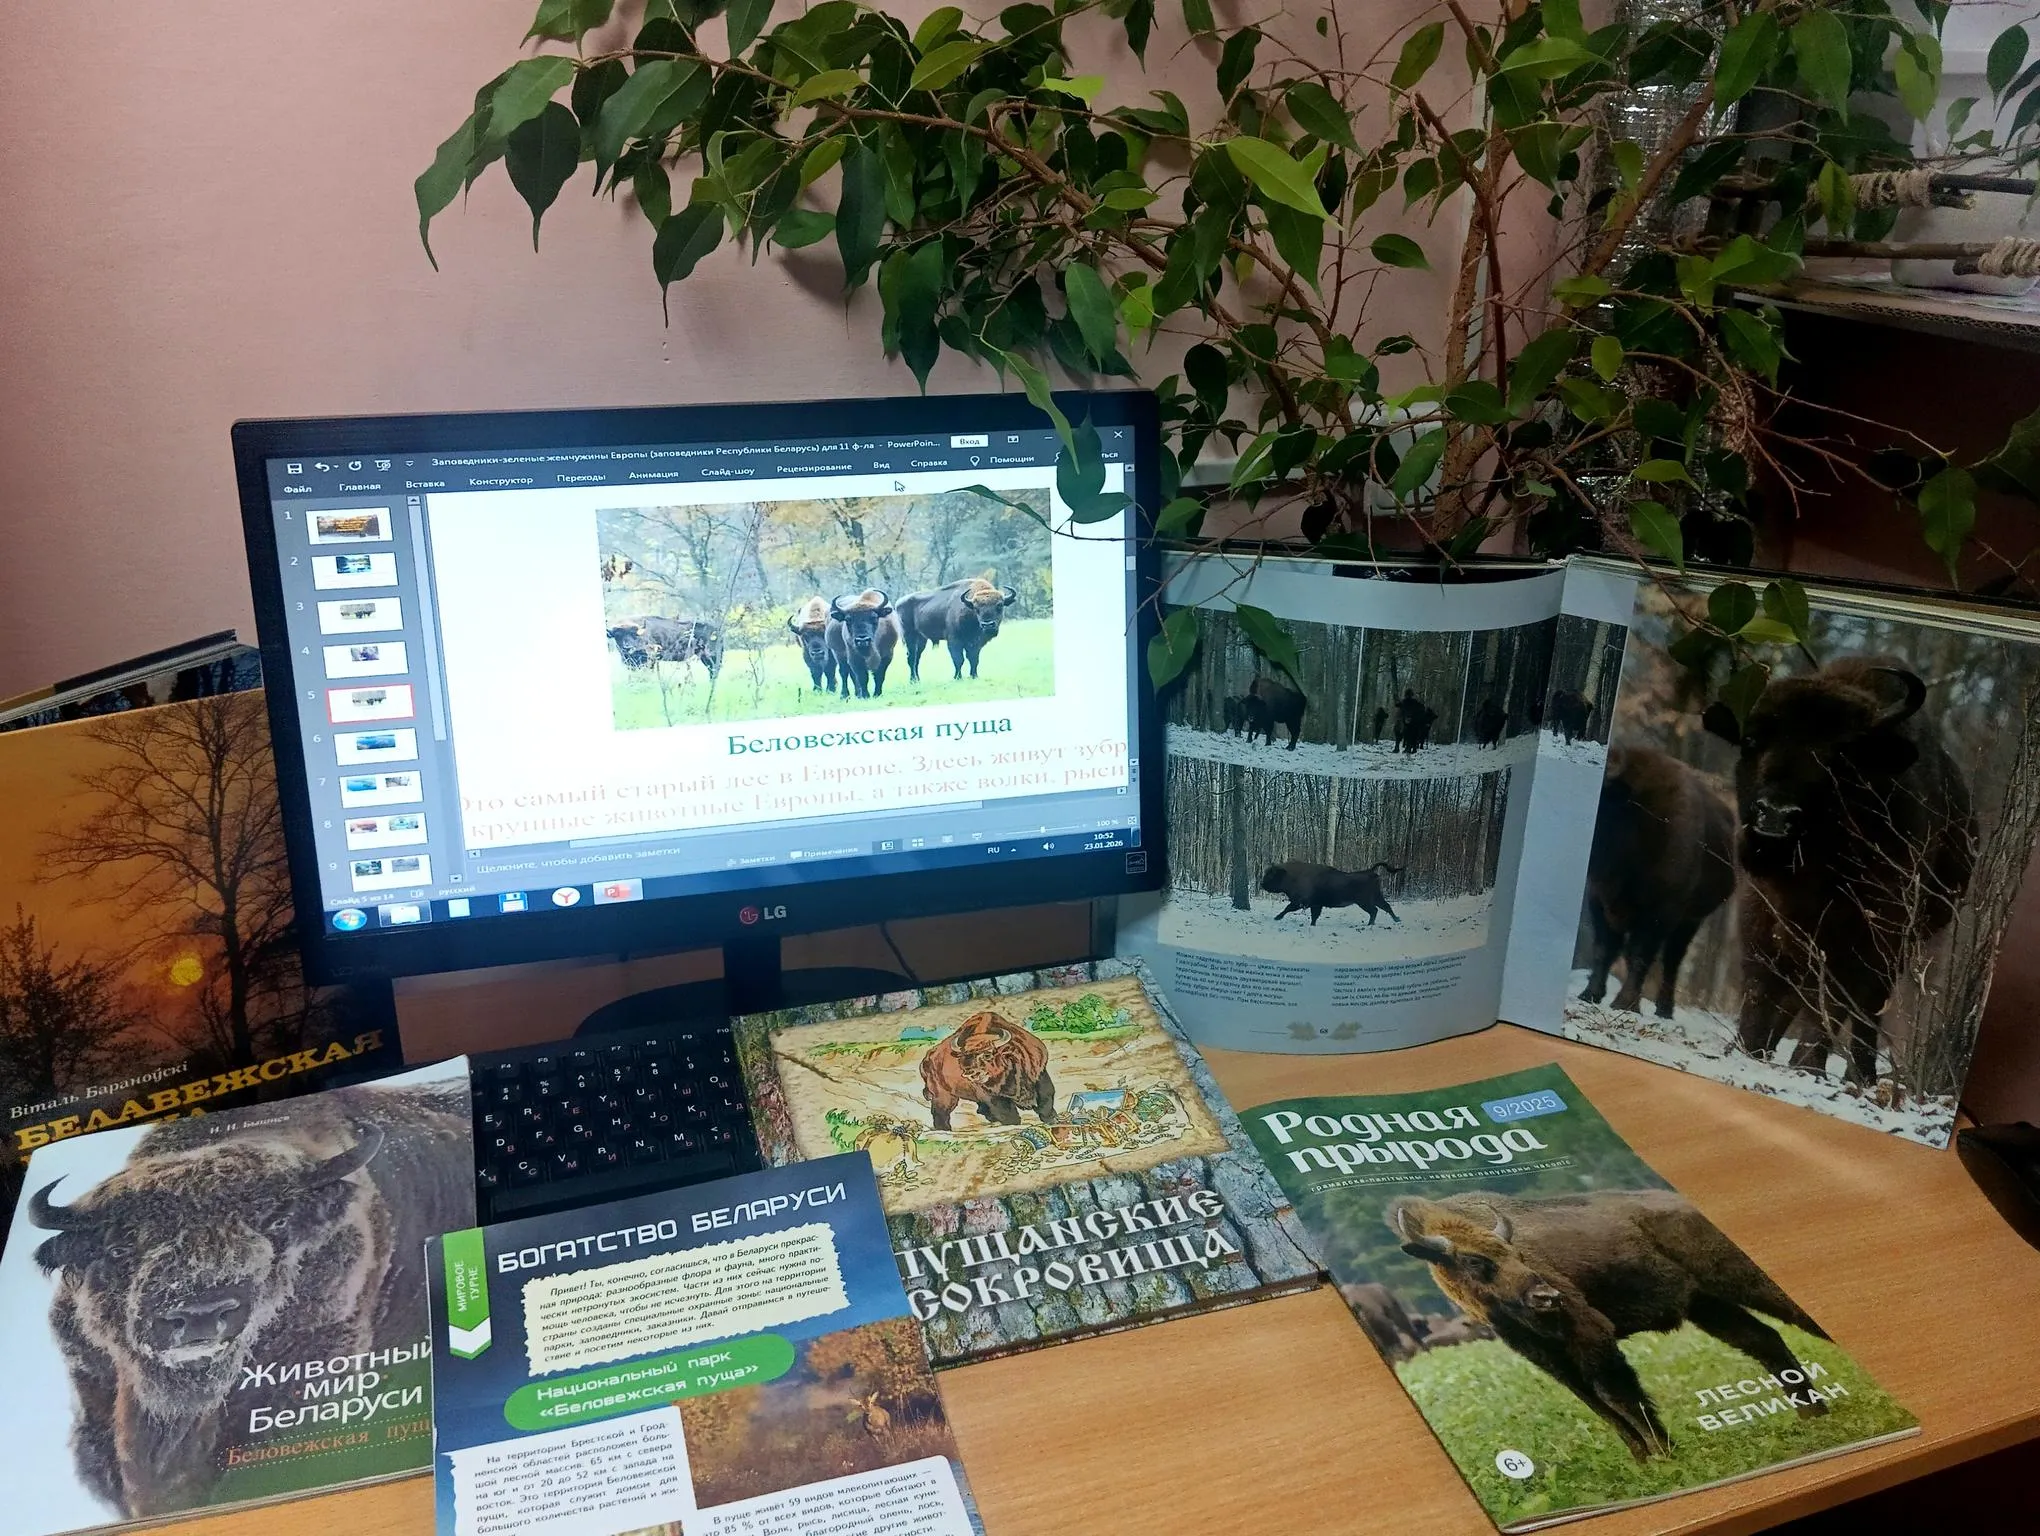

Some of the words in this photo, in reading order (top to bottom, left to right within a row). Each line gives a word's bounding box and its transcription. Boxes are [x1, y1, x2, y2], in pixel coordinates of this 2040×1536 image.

[431, 453, 545, 466] Заповедники-зеленые
[546, 452, 608, 463] жемчужины
[611, 451, 648, 460] Европы
[650, 447, 714, 459] (заповедники
[716, 446, 772, 456] Республики
[774, 443, 820, 455] Беларусь)
[822, 444, 838, 452] для
[852, 442, 874, 452] ф-ла
[960, 437, 980, 446] Вход
[284, 485, 312, 494] Файл
[339, 483, 381, 492] Главная
[405, 480, 446, 489] Вставка
[469, 476, 534, 487] Конструктор
[557, 474, 606, 484] Переходы
[629, 471, 679, 480] Анимация
[701, 466, 756, 478] Слайд-шоу
[777, 463, 852, 474] Рецензирование
[873, 461, 890, 470] Вид
[911, 458, 948, 468] Справка
[990, 454, 1034, 464] Помощни
[728, 724, 924, 756] Беловежская
[935, 716, 1012, 742] пуща
[513, 783, 606, 808] самый
[616, 774, 716, 800] старый
[726, 771, 769, 789] лес
[911, 755, 983, 774] Здесь
[991, 746, 1068, 769] живут
[470, 813, 597, 842] крупные
[605, 799, 745, 827] животные
[896, 777, 969, 797] также
[987, 846, 1000, 855] RU
[1084, 840, 1124, 850] 23.01.2026
[1094, 831, 1114, 840] 10:52
[764, 904, 787, 920] LG
[10, 1093, 80, 1120] Віталь
[84, 1060, 190, 1100] Бараноўскі
[13, 1027, 385, 1152] БЕЛАВЕЖСКАЯ
[688, 1104, 696, 1113] K
[1492, 1096, 1557, 1118] 9/2025
[1259, 1105, 1481, 1144] Родная
[1285, 1127, 1549, 1175] прырода
[498, 1219, 678, 1274] БОГАТСТВО
[692, 1182, 847, 1233] БЕЛАРУСИ
[470, 1266, 480, 1301] ТУРНЕ
[540, 1302, 556, 1310] ная
[560, 1292, 602, 1307] природа:
[606, 1275, 679, 1298] разнообразные
[682, 1270, 712, 1282] флора
[724, 1260, 755, 1272] фауна,
[758, 1254, 786, 1264] много
[788, 1245, 822, 1259] практи-
[550, 1282, 587, 1296] Привет!
[607, 1270, 648, 1285] конечно,
[650, 1258, 710, 1276] согласишься,
[712, 1254, 727, 1262] что
[736, 1243, 779, 1258] Беларуси
[780, 1234, 820, 1248] прекрас-
[906, 1227, 1240, 1321] СОКРОВИЩА
[452, 1260, 467, 1313] МИРОВОЕ
[540, 1310, 568, 1321] чески
[571, 1298, 626, 1315] нетронутых
[629, 1286, 680, 1303] экосистем.
[684, 1280, 710, 1290] Части
[726, 1273, 743, 1282] них
[746, 1265, 776, 1278] сейчас
[779, 1260, 807, 1271] нужна
[542, 1320, 569, 1332] мощь
[571, 1310, 618, 1324] человека,
[620, 1303, 648, 1316] чтобы
[664, 1291, 712, 1306] исчезнуть.
[714, 1286, 733, 1296] Для
[736, 1280, 760, 1292] этого
[776, 1266, 827, 1282] территории
[542, 1329, 577, 1342] страны
[580, 1320, 621, 1334] созданы
[624, 1306, 685, 1327] специальные
[688, 1296, 734, 1311] охранные
[736, 1290, 762, 1301] зоны:
[765, 1276, 830, 1294] национальные
[544, 1340, 575, 1353] парки,
[579, 1326, 642, 1345] заповедники,
[646, 1316, 697, 1332] заказники.
[700, 1307, 729, 1320] Давай
[732, 1295, 785, 1312] отправимся
[796, 1286, 832, 1299] путеше-
[238, 1334, 433, 1390] Животный
[544, 1350, 571, 1362] ствие
[584, 1339, 624, 1355] посетим
[626, 1328, 678, 1344] некоторые
[303, 1371, 380, 1400] мир
[536, 1359, 678, 1401] Национальный
[688, 1349, 732, 1369] парк
[539, 1380, 687, 1418] «Беловежская
[696, 1363, 759, 1387] пуща»
[1696, 1359, 1829, 1408] ЛЕСНОЙ
[250, 1386, 423, 1434] Беларуси
[1698, 1382, 1850, 1432] ВЕЛИКАН
[228, 1430, 369, 1466] Беловежская
[474, 1462, 518, 1478] ненской
[522, 1452, 571, 1469] областей
[575, 1440, 638, 1458] расположен
[642, 1433, 671, 1444] боль-
[507, 1444, 567, 1460] территории
[571, 1430, 625, 1448] Брестской
[640, 1422, 669, 1433] Грод-
[503, 1470, 540, 1483] лесной
[638, 1443, 673, 1456] севера
[623, 1458, 658, 1470] запада
[1504, 1457, 1528, 1472] 6+
[476, 1500, 515, 1512] восток.
[520, 1494, 540, 1504] Это
[544, 1480, 603, 1498] территория
[606, 1464, 676, 1485] Беловежской
[476, 1512, 509, 1524] пущи,
[517, 1500, 561, 1516] которая
[569, 1491, 606, 1504] служит
[616, 1482, 651, 1495] домом
[724, 1511, 752, 1524] пуще
[804, 1490, 834, 1502] видов
[837, 1472, 918, 1496] млекопитающих
[774, 1512, 798, 1523] всех
[802, 1504, 836, 1516] видов,
[838, 1492, 882, 1507] которые
[885, 1480, 927, 1497] обитают
[477, 1518, 532, 1535] большого
[534, 1505, 595, 1523] количества
[599, 1493, 648, 1510] растений
[762, 1524, 794, 1536] Волк,
[798, 1518, 827, 1532] рысь,
[831, 1506, 870, 1521] лисица,
[875, 1496, 910, 1510] лесная
[805, 1516, 875, 1536] благородный
[880, 1508, 914, 1521] олень,
[874, 1520, 908, 1535] другие
[912, 1510, 948, 1524] живот-
